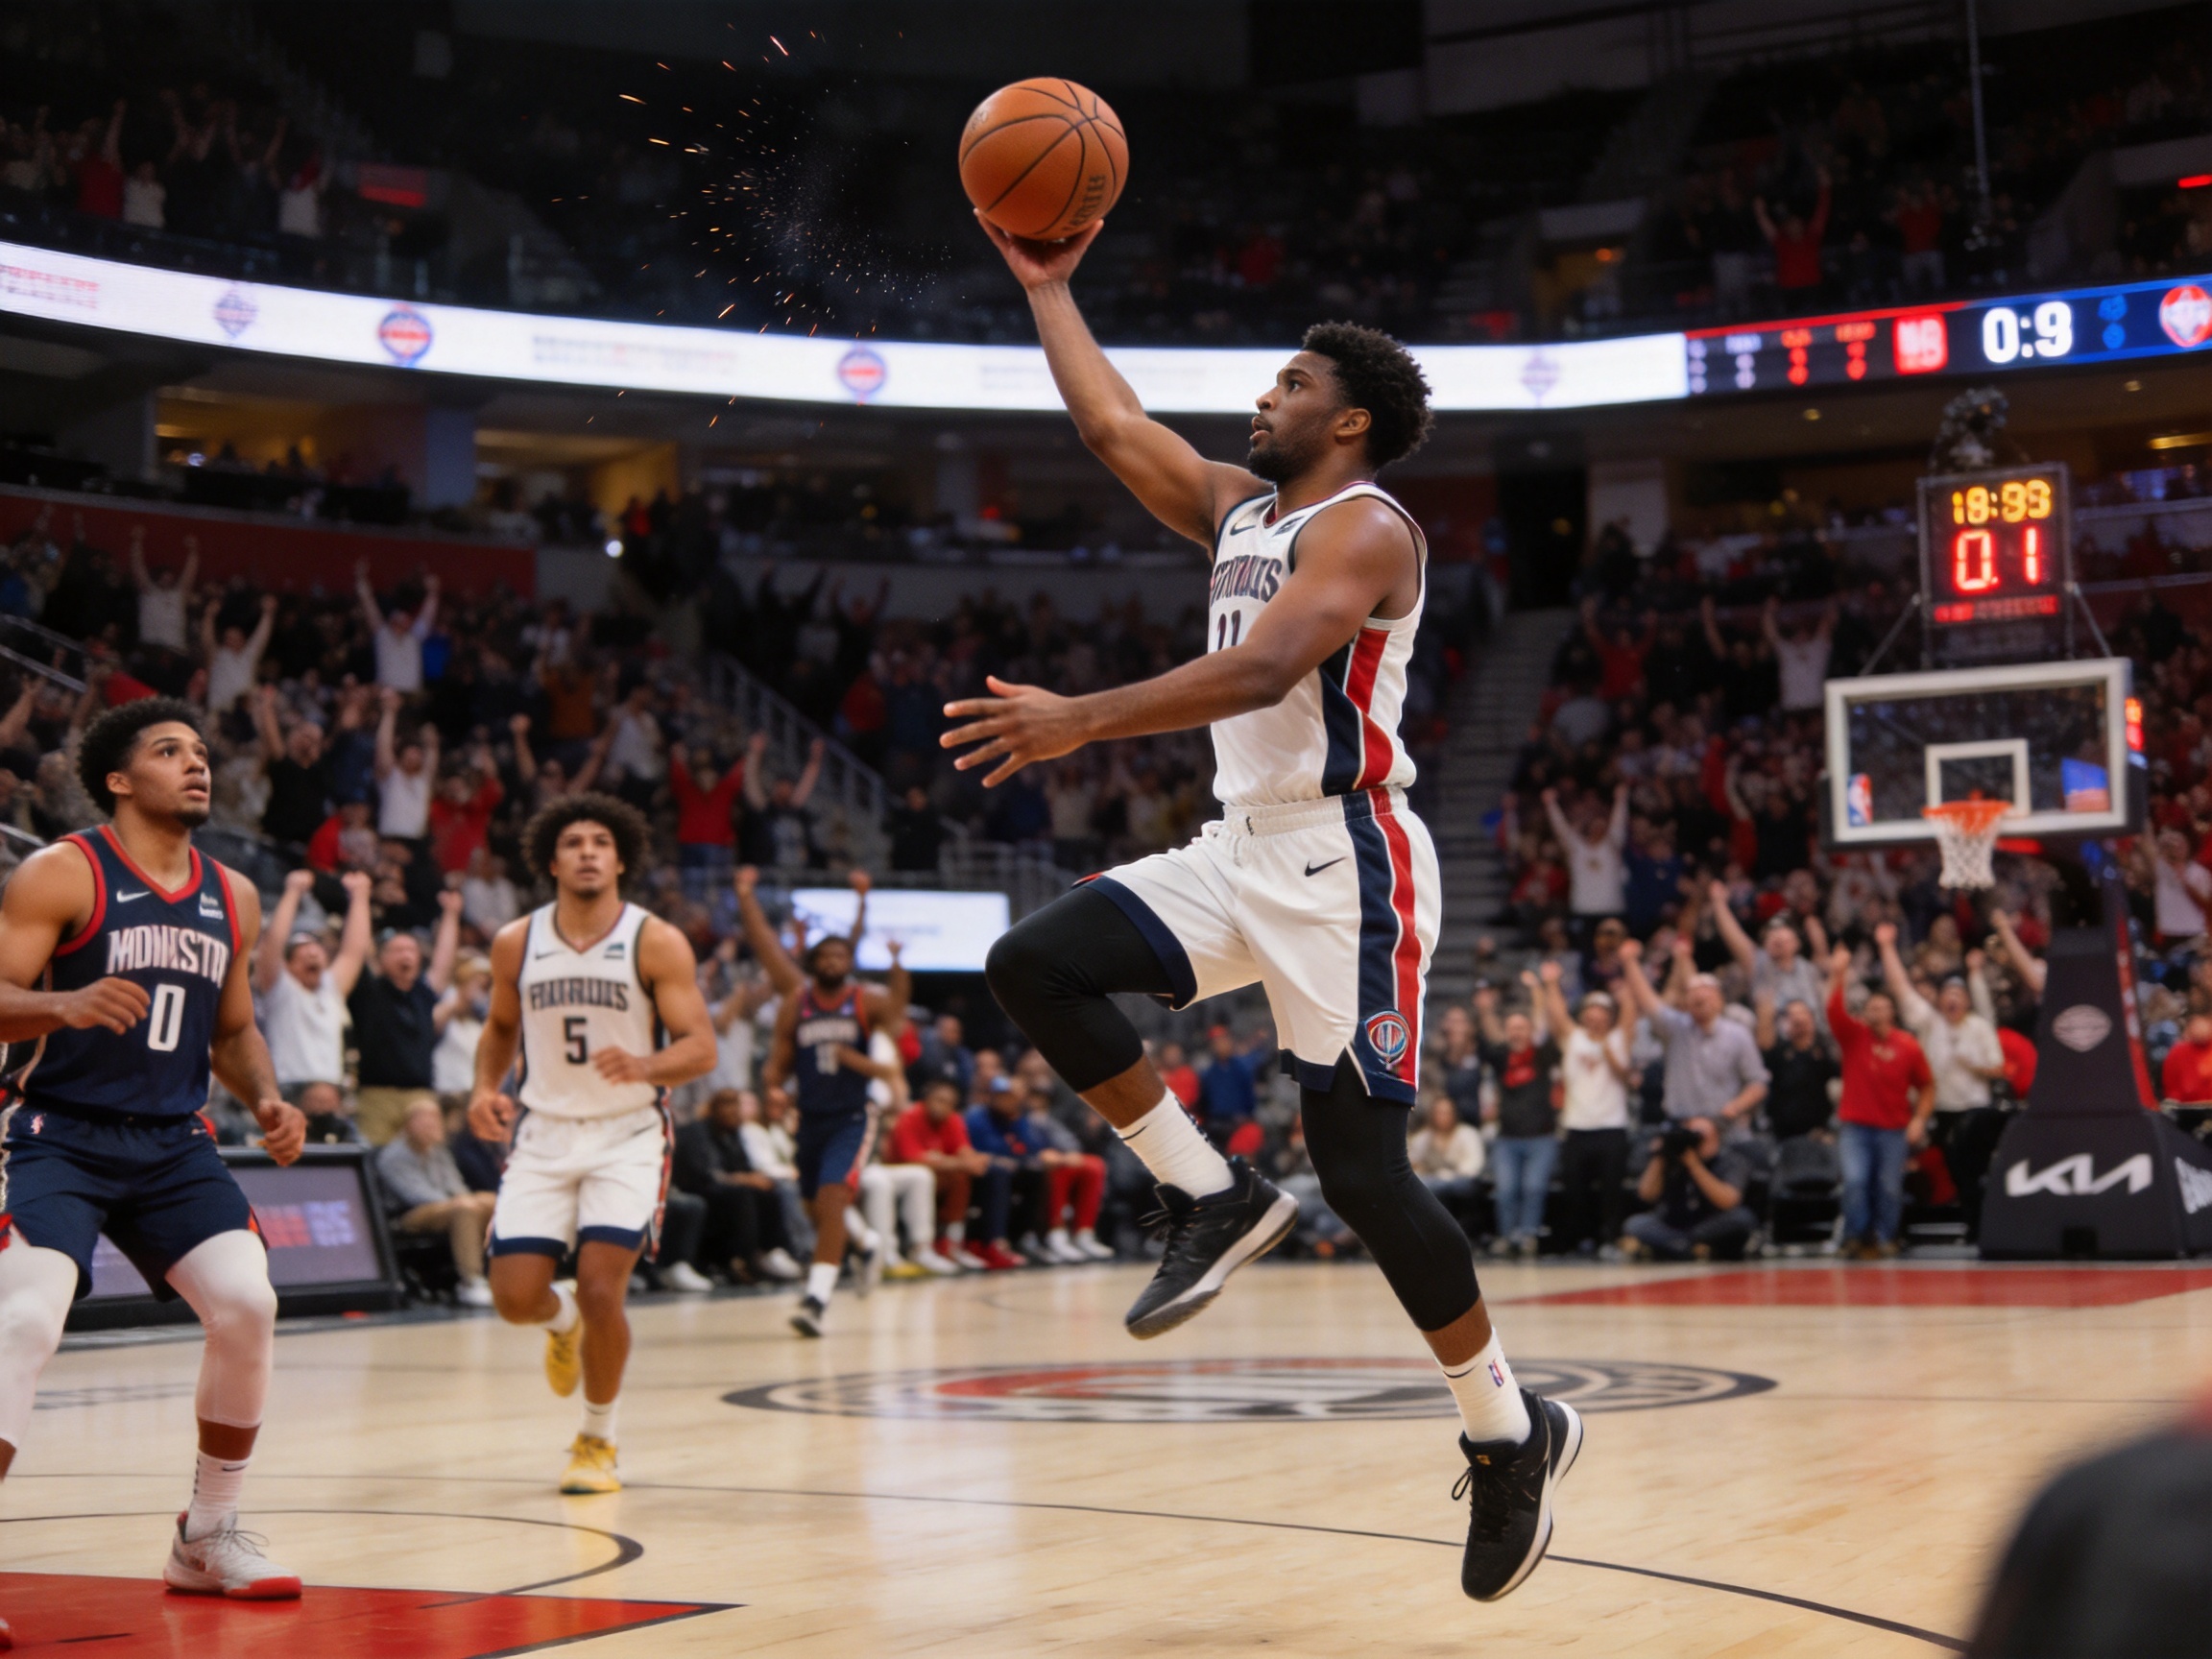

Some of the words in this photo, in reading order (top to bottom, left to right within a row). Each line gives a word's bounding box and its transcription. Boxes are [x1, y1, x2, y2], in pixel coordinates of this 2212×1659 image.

[1983, 301, 2073, 364] 0:9
[147, 983, 186, 1052] 0
[564, 1017, 588, 1065] 5
